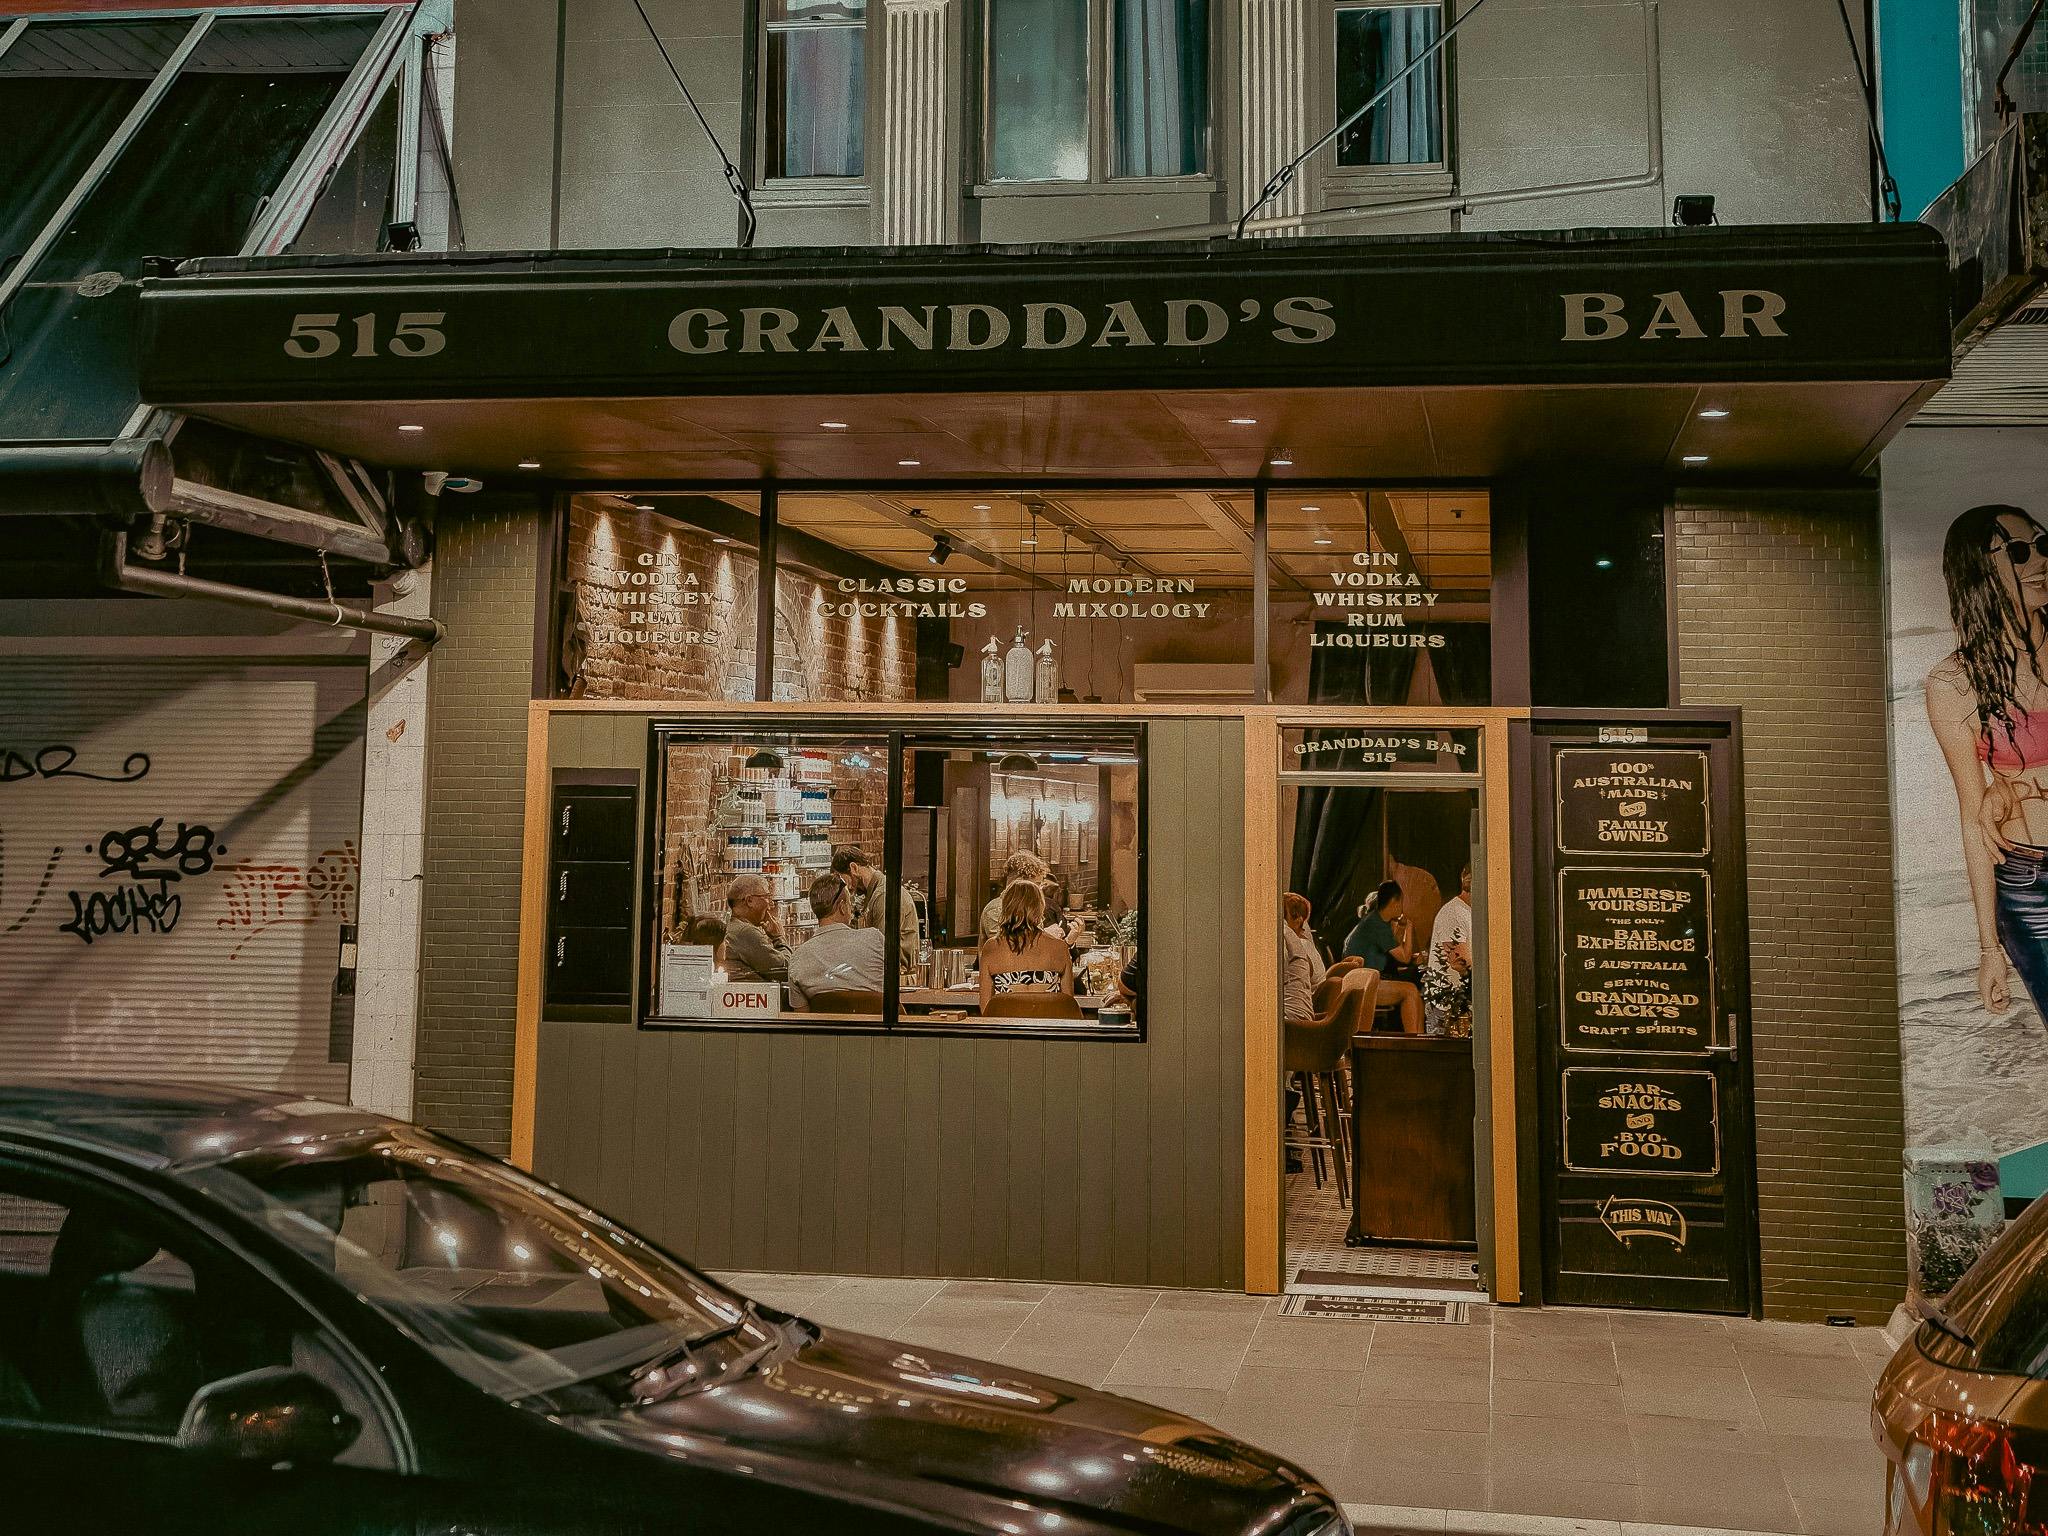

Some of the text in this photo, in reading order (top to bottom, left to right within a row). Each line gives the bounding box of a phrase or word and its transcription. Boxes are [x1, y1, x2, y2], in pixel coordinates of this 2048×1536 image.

[668, 290, 1789, 354] GRANDDAD'S BAR
[284, 312, 446, 358] 515
[637, 553, 680, 566] GIN
[1352, 552, 1399, 566] GIN
[615, 572, 700, 585] VODKA
[838, 578, 967, 593] CLASSIC
[1330, 572, 1421, 586] VODKA
[1067, 578, 1196, 594] MODERN
[600, 591, 716, 605] WHISKEY
[1313, 592, 1439, 607] WHISKEY
[819, 602, 987, 618] COCKTAILS
[1052, 602, 1212, 618] MIXOLOGY
[629, 611, 683, 624] RUM
[1347, 613, 1405, 627] RUM
[593, 630, 719, 644] LIQUEURS
[1309, 633, 1446, 648] LIQUEURS
[1293, 737, 1466, 755] GRANDDAD'S BAR
[1362, 752, 1397, 763] 515
[1573, 776, 1692, 790] AUSTRALIAN
[1607, 788, 1658, 800] MADE
[1622, 804, 1643, 815] AND
[1598, 819, 1668, 832] FAMILY
[1598, 830, 1669, 843] OWNED
[1578, 887, 1691, 903] IMMERSE
[1587, 899, 1683, 913] YOURSELF
[1614, 929, 1657, 941] BAR
[1577, 935, 1695, 951] EXPERIENCE
[1599, 960, 1688, 971] AUSTRALIA
[1604, 979, 1670, 991] SERVING
[723, 992, 768, 1009] OPEN
[1575, 991, 1699, 1006] GRANDDAD
[1595, 1004, 1680, 1019] JACK'S
[1578, 1024, 1698, 1036] CRAFT SPIRITS
[1618, 1083, 1661, 1096] BAR
[1598, 1095, 1682, 1111] SNACKS
[1630, 1118, 1650, 1126] AND
[1600, 1142, 1682, 1160] FOOD
[1610, 1208, 1673, 1226] THIS WAY
[1321, 1303, 1426, 1314] WELCOME
